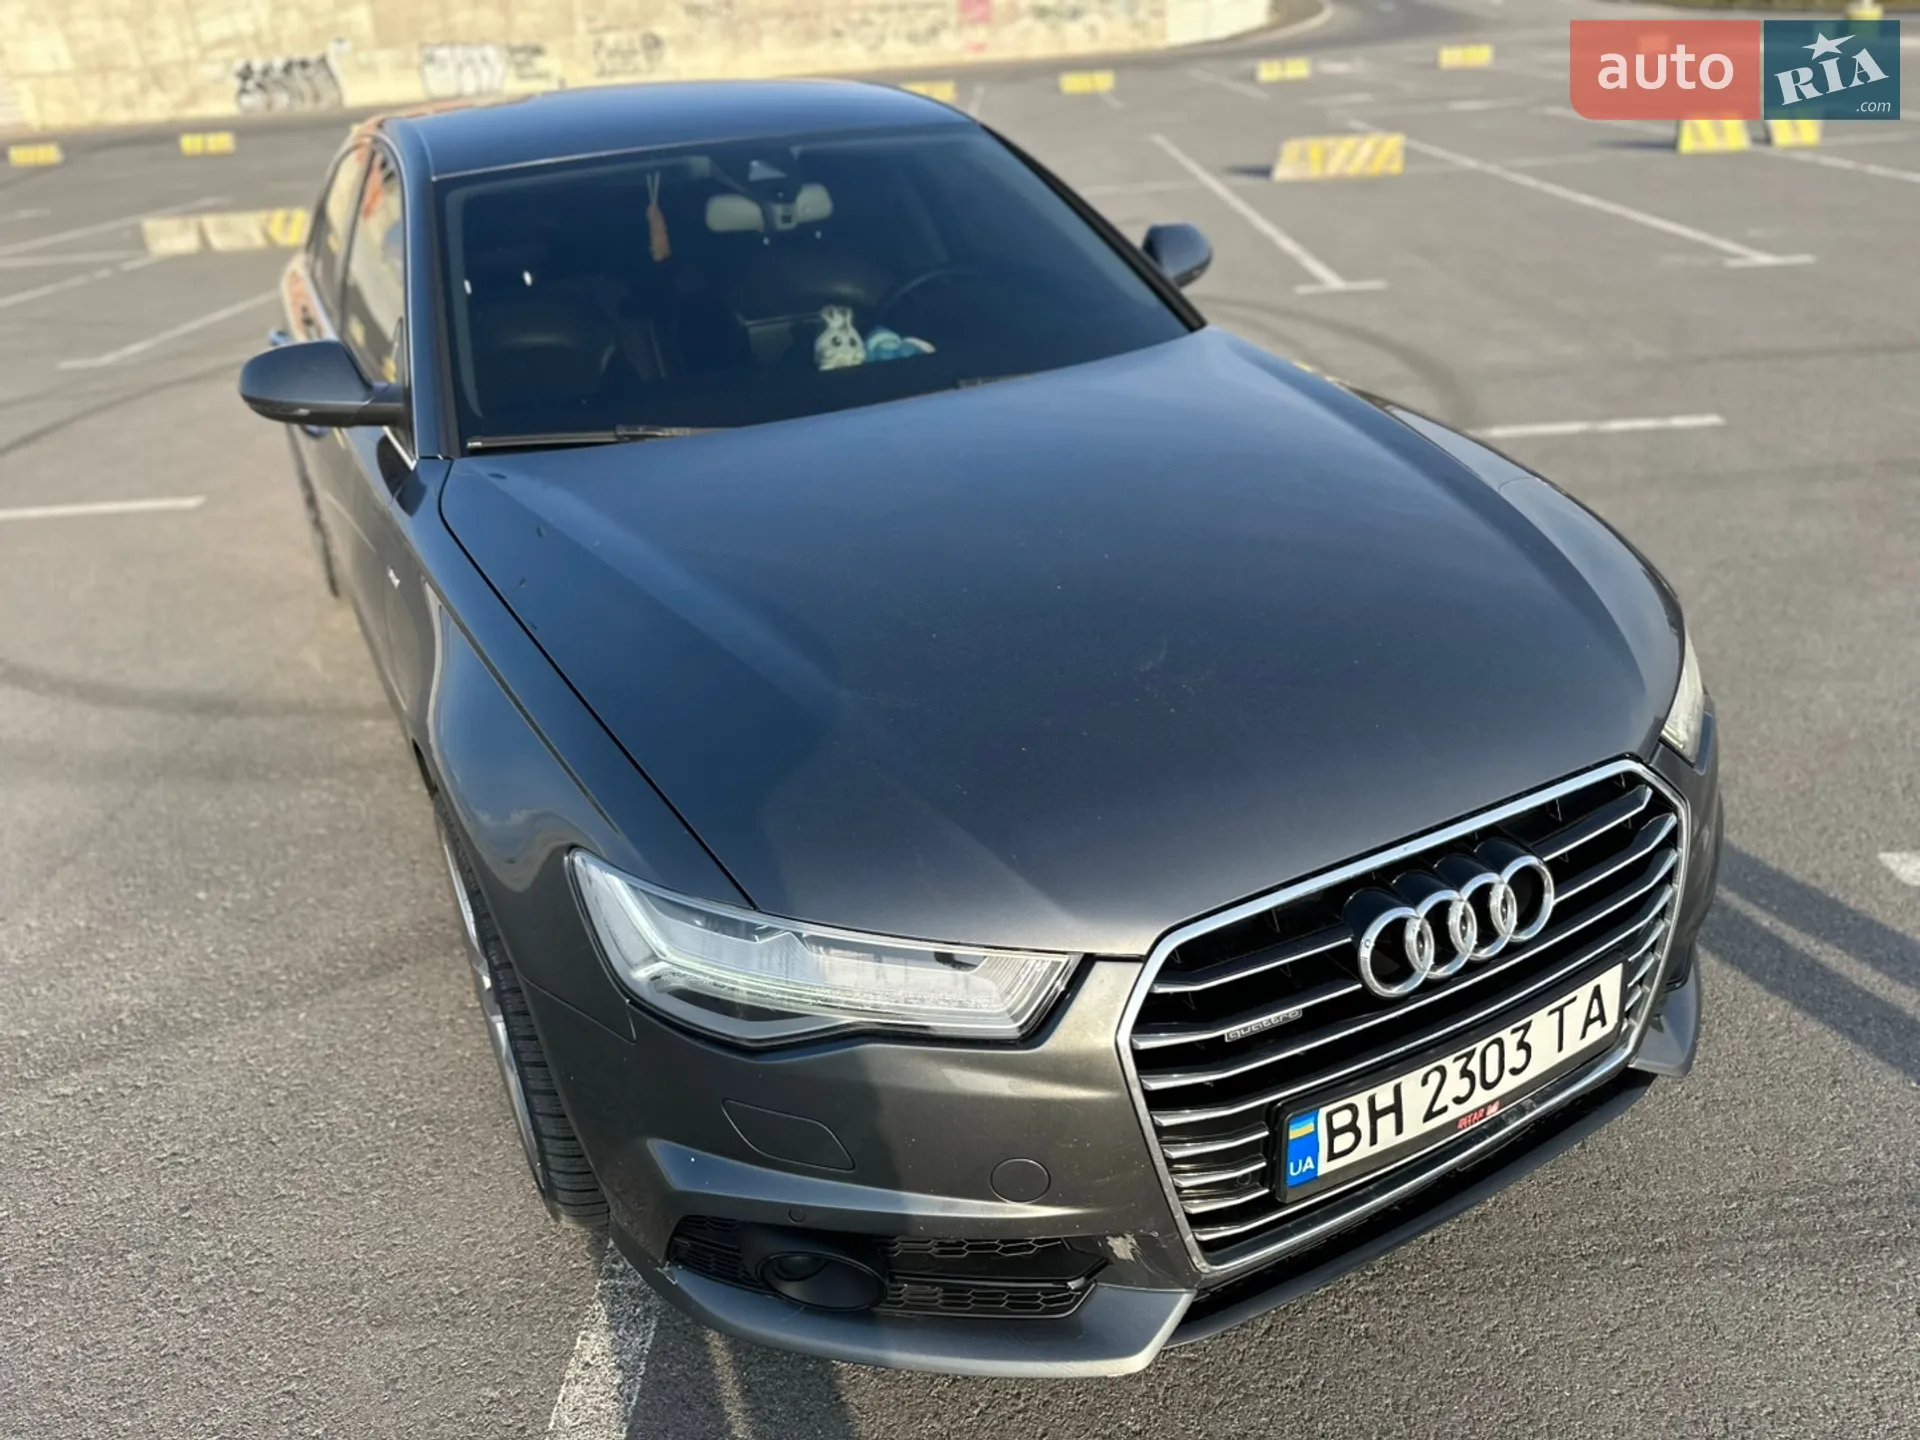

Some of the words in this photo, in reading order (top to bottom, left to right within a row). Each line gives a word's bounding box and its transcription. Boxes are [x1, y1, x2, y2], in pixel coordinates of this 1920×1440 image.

[1228, 1009, 1300, 1040] quattro
[1325, 1081, 1404, 1163] BH
[1420, 1020, 1532, 1123] 2303
[1548, 984, 1607, 1053] TA
[1289, 1158, 1315, 1177] UA
